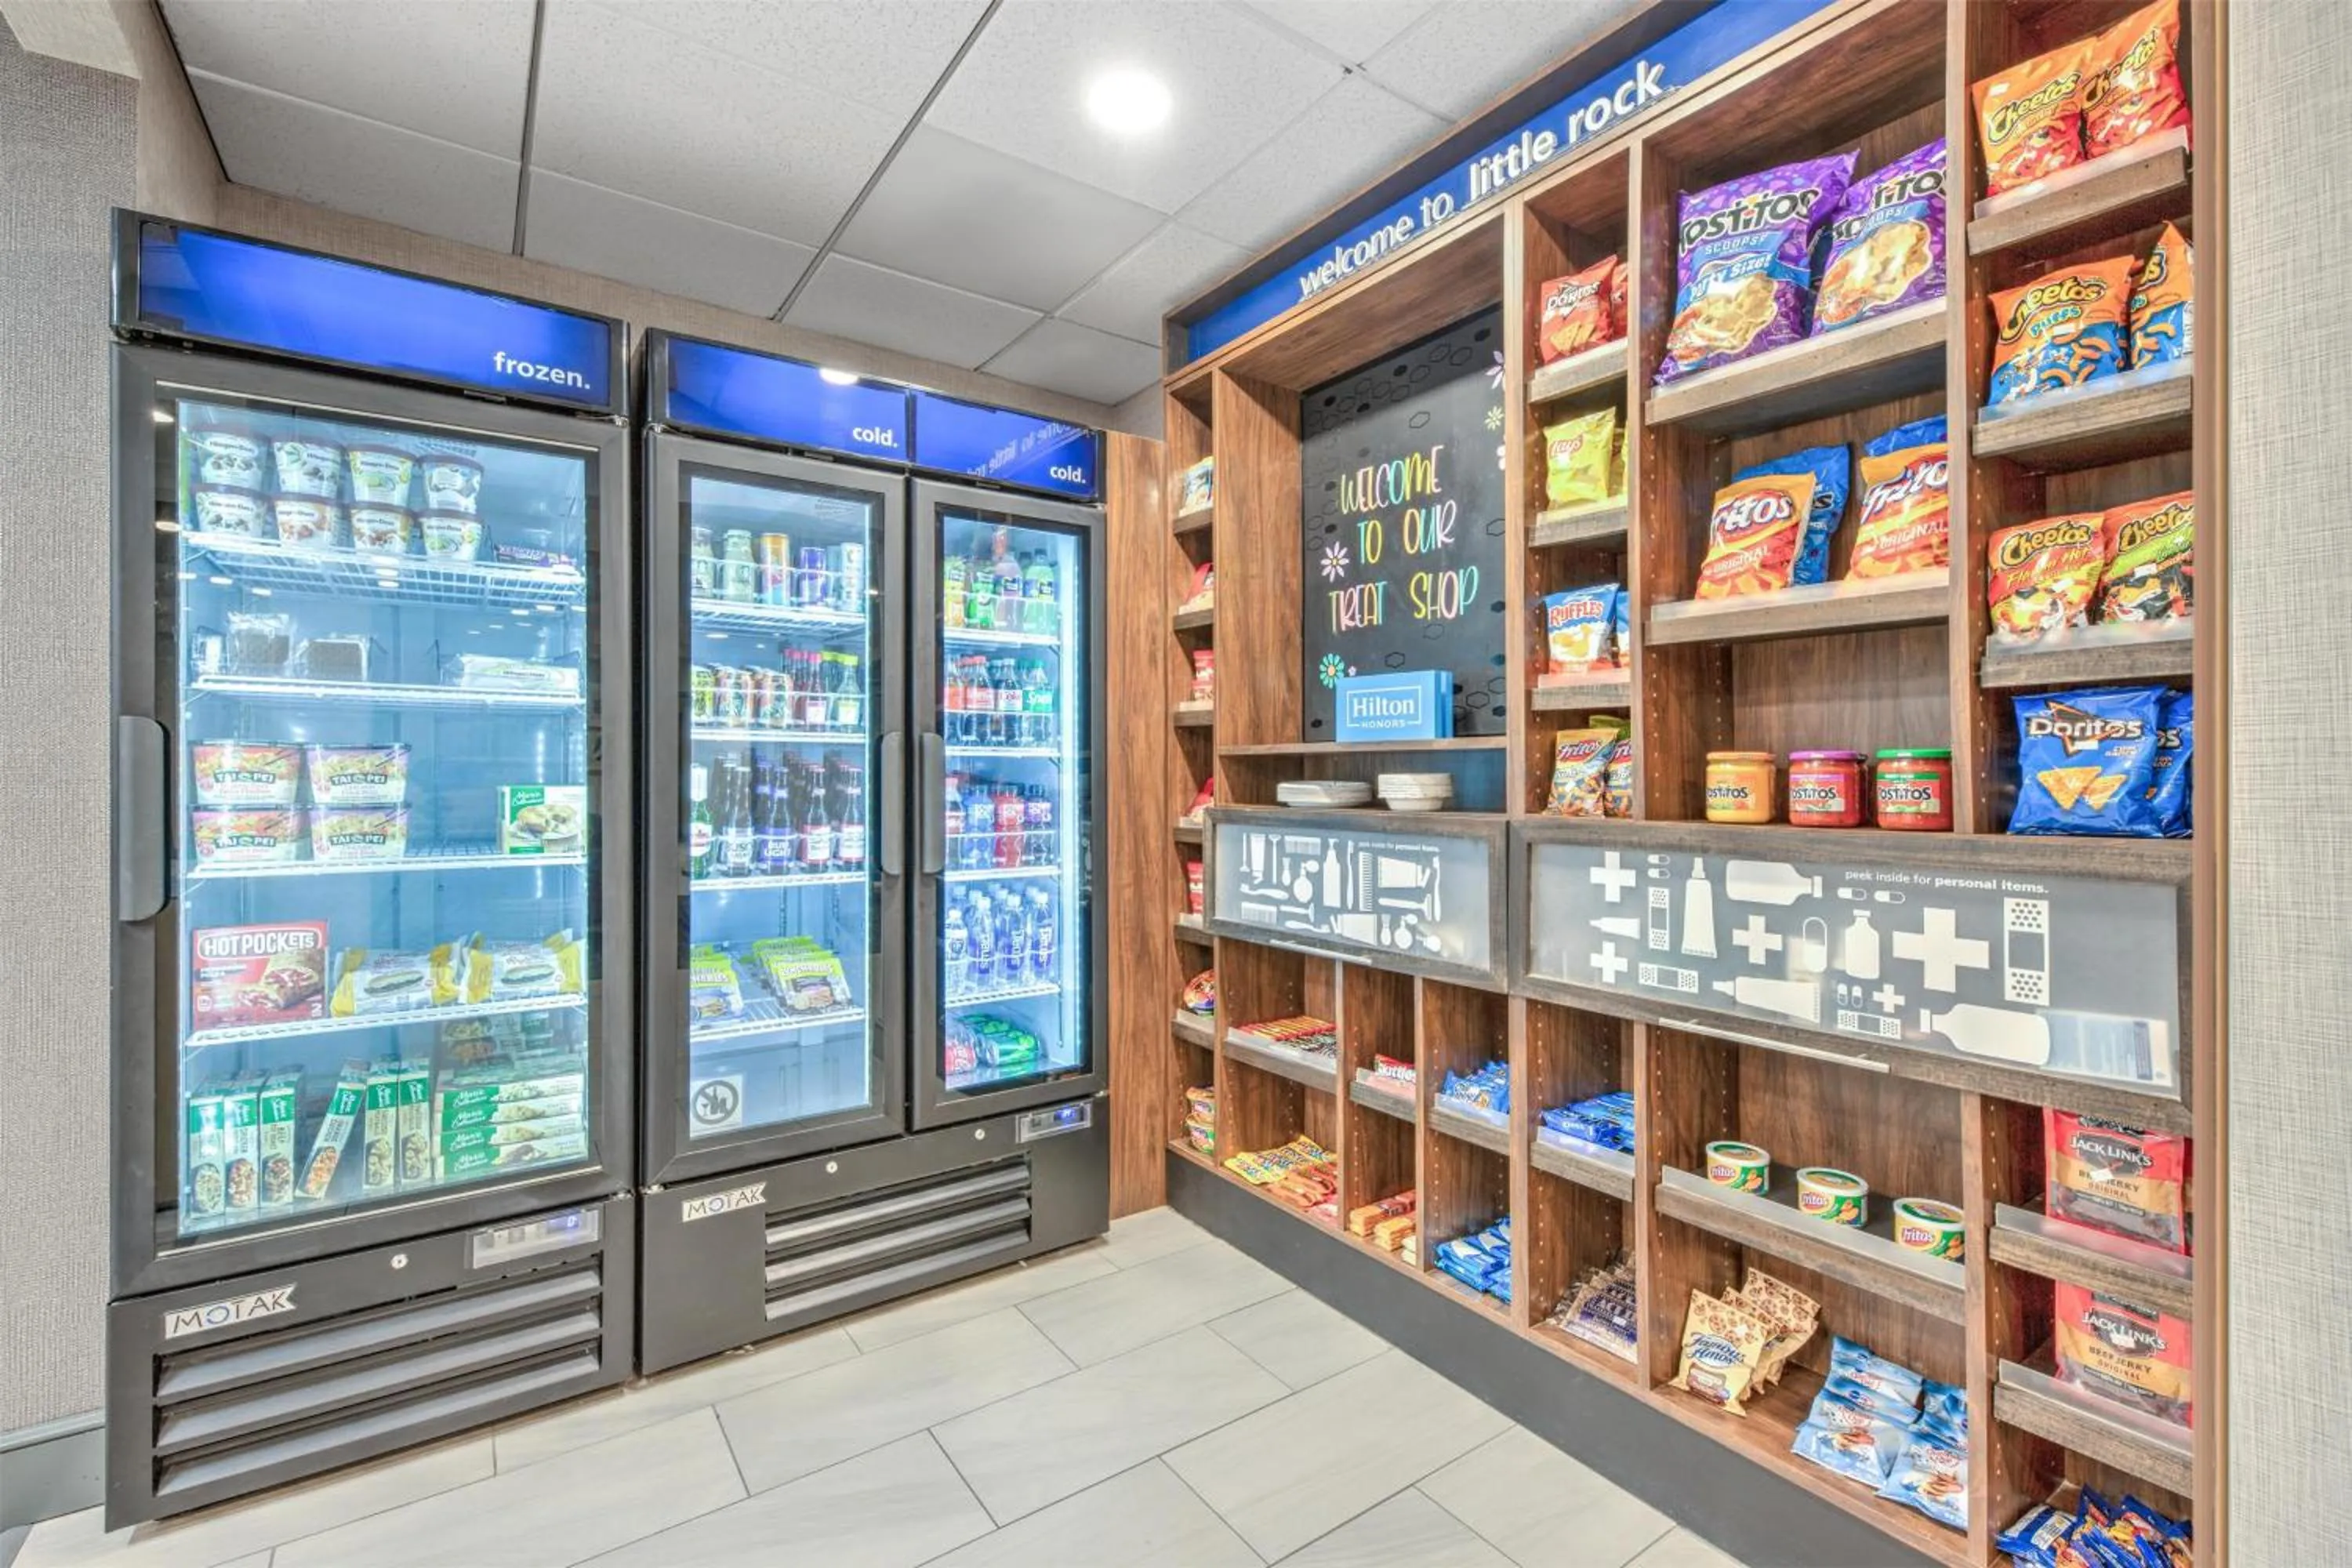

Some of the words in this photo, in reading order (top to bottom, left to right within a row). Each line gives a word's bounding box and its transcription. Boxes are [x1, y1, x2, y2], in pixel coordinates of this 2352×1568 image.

[1989, 71, 2081, 143] Cheetos
[1300, 213, 1414, 296] welcome
[1421, 191, 1454, 227] to
[1468, 129, 1558, 202] little
[1569, 60, 1666, 143] rock
[493, 350, 590, 390] frozen.
[852, 426, 898, 448] cold.
[1050, 465, 1087, 484] cold.
[1341, 445, 1444, 514] WELCOME
[1860, 460, 1947, 524] Frito
[1357, 520, 1383, 565] TO
[1403, 499, 1457, 555] OUR
[2001, 521, 2091, 566] Cheetos
[1328, 580, 1388, 637] TREAT
[1410, 565, 1479, 620] SHOP
[1549, 601, 1604, 626] RUFFLES
[1353, 696, 1414, 717] Hilton
[1362, 720, 1406, 728] HONORS
[2028, 717, 2143, 738] Doritos
[1845, 869, 1872, 881] peek
[1876, 871, 1911, 884] inside
[1914, 873, 1932, 884] for
[1934, 876, 1997, 890] personal
[2002, 879, 2049, 894] items.
[205, 936, 241, 956] HOT
[242, 931, 315, 954] POCKETS
[2070, 1136, 2108, 1156] JACK
[687, 1186, 764, 1220] MOTAK
[172, 1292, 286, 1335] MOTAK
[2082, 1310, 2117, 1334] JACK
